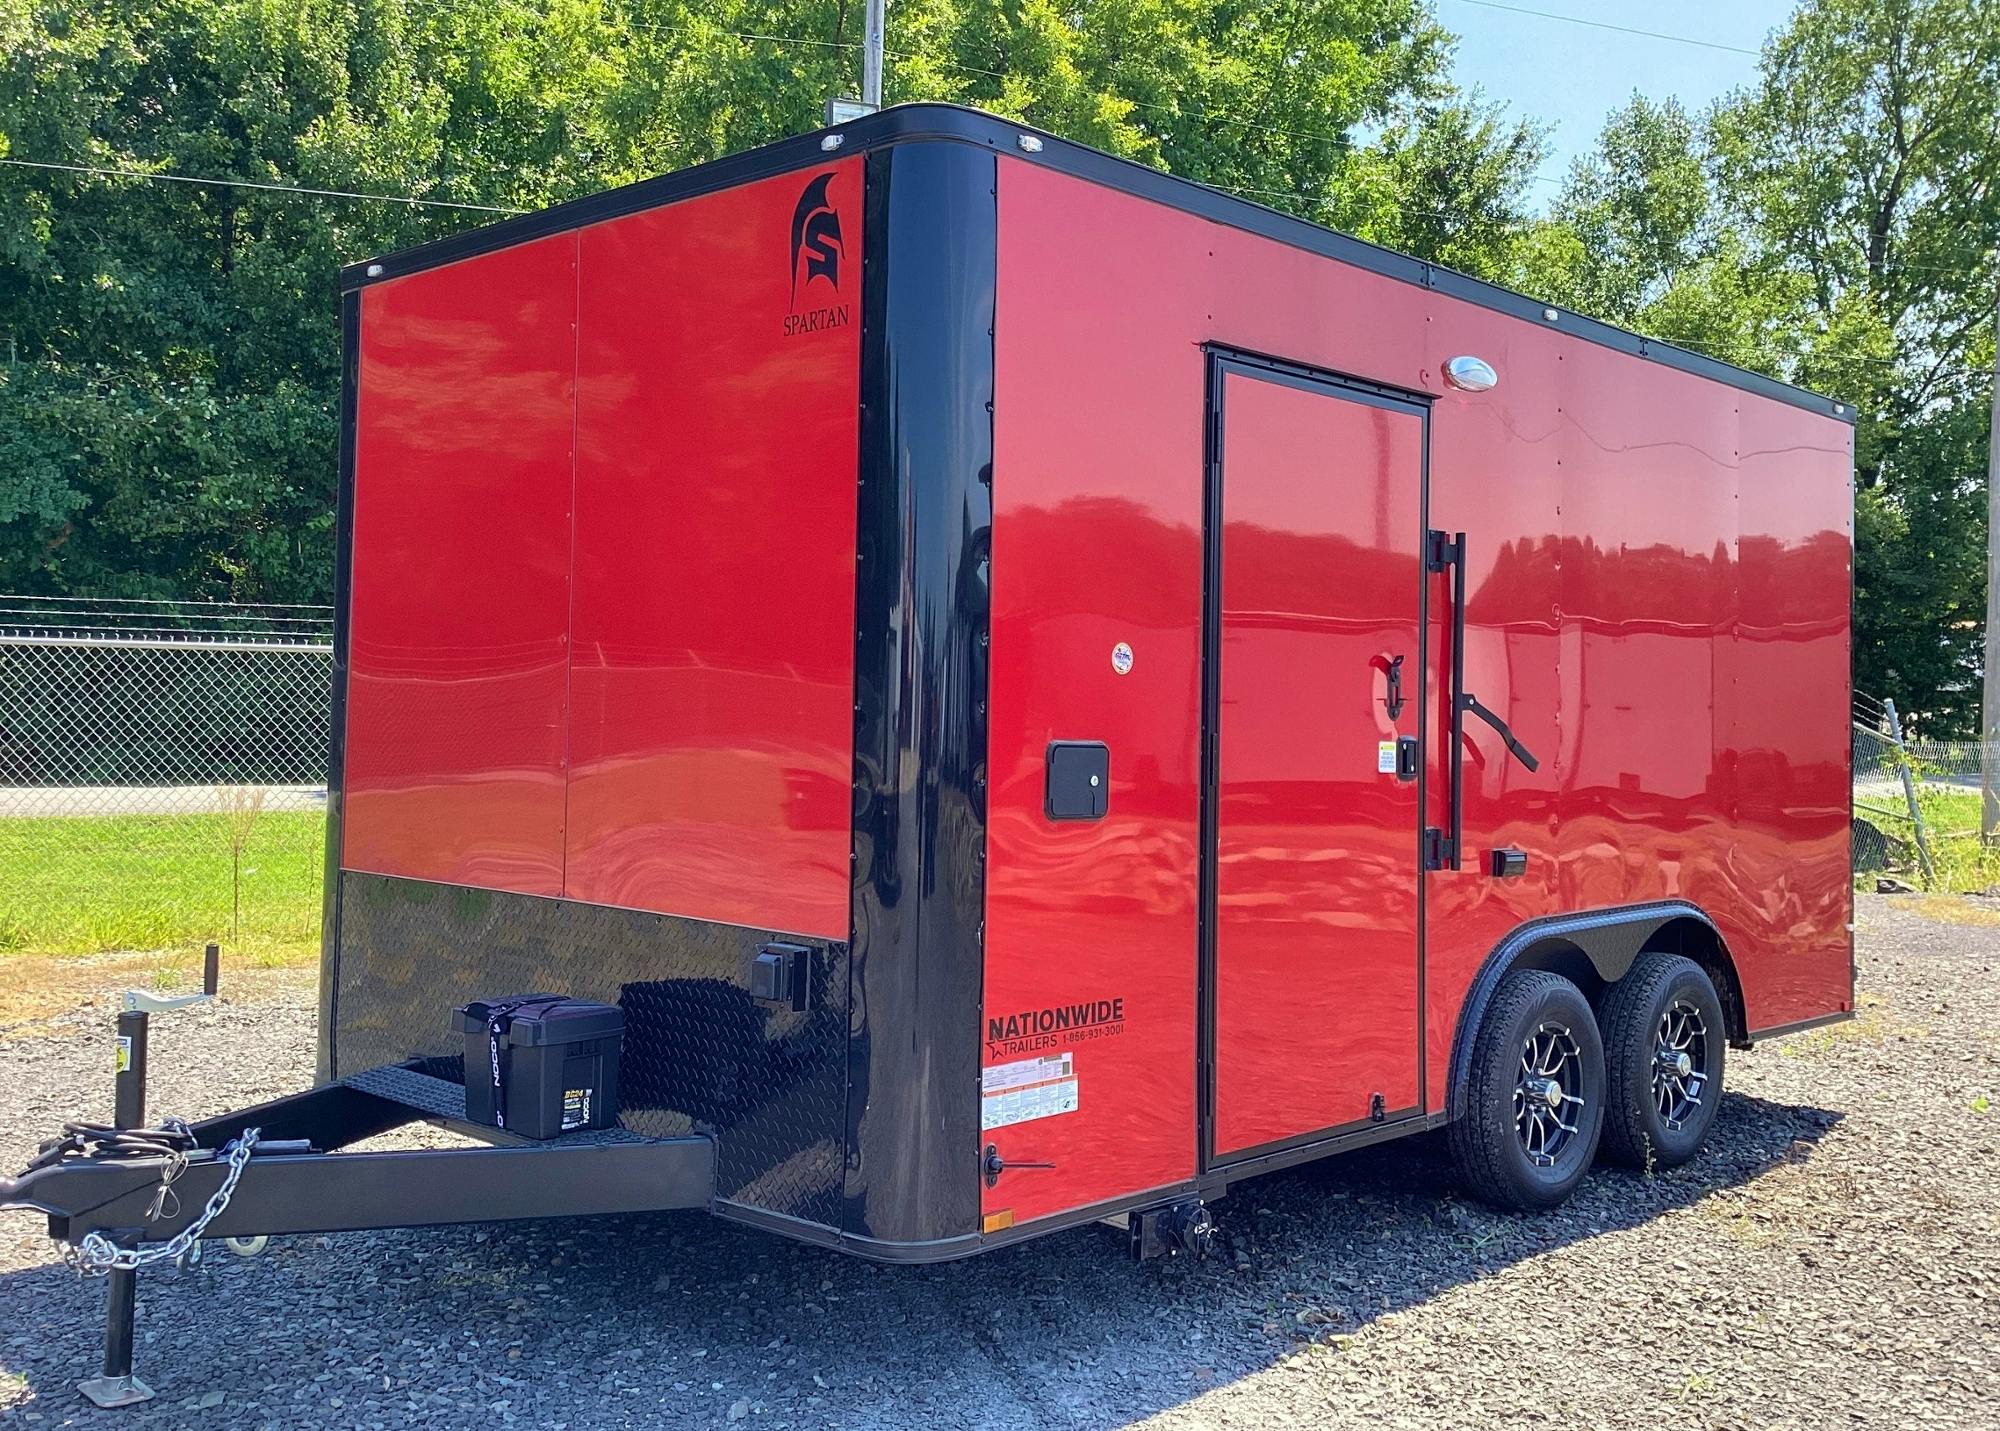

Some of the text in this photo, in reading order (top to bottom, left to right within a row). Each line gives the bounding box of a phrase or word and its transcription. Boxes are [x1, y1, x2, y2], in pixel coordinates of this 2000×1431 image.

[783, 304, 849, 337] SPARTAN
[989, 998, 1123, 1041] NATIONWIDE
[490, 1040, 500, 1087] NOCO
[1002, 1034, 1058, 1056] TRAILERS
